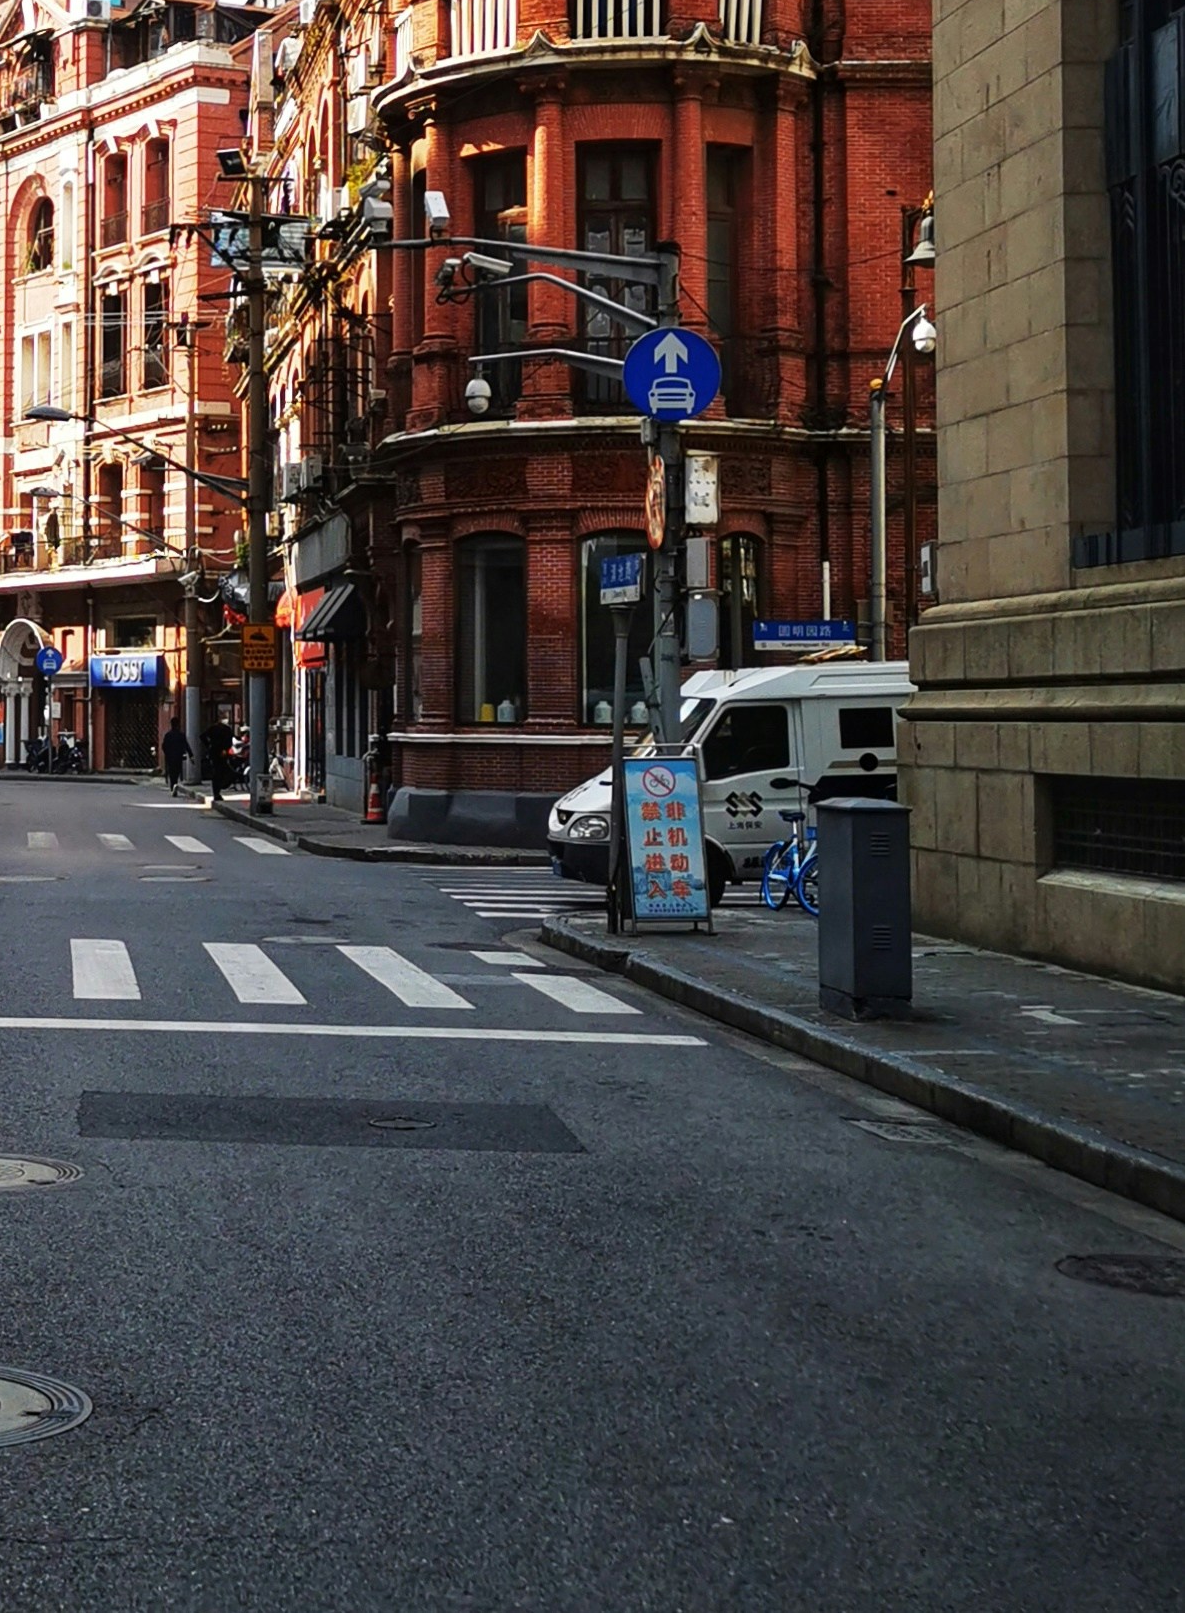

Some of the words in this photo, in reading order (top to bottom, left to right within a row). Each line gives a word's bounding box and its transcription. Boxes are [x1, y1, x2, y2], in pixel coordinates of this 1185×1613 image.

[102, 659, 145, 683] ROSSI
[640, 800, 668, 900] 禁止进入
[665, 800, 692, 900] 非机动车
[728, 821, 763, 830] 上海保安
